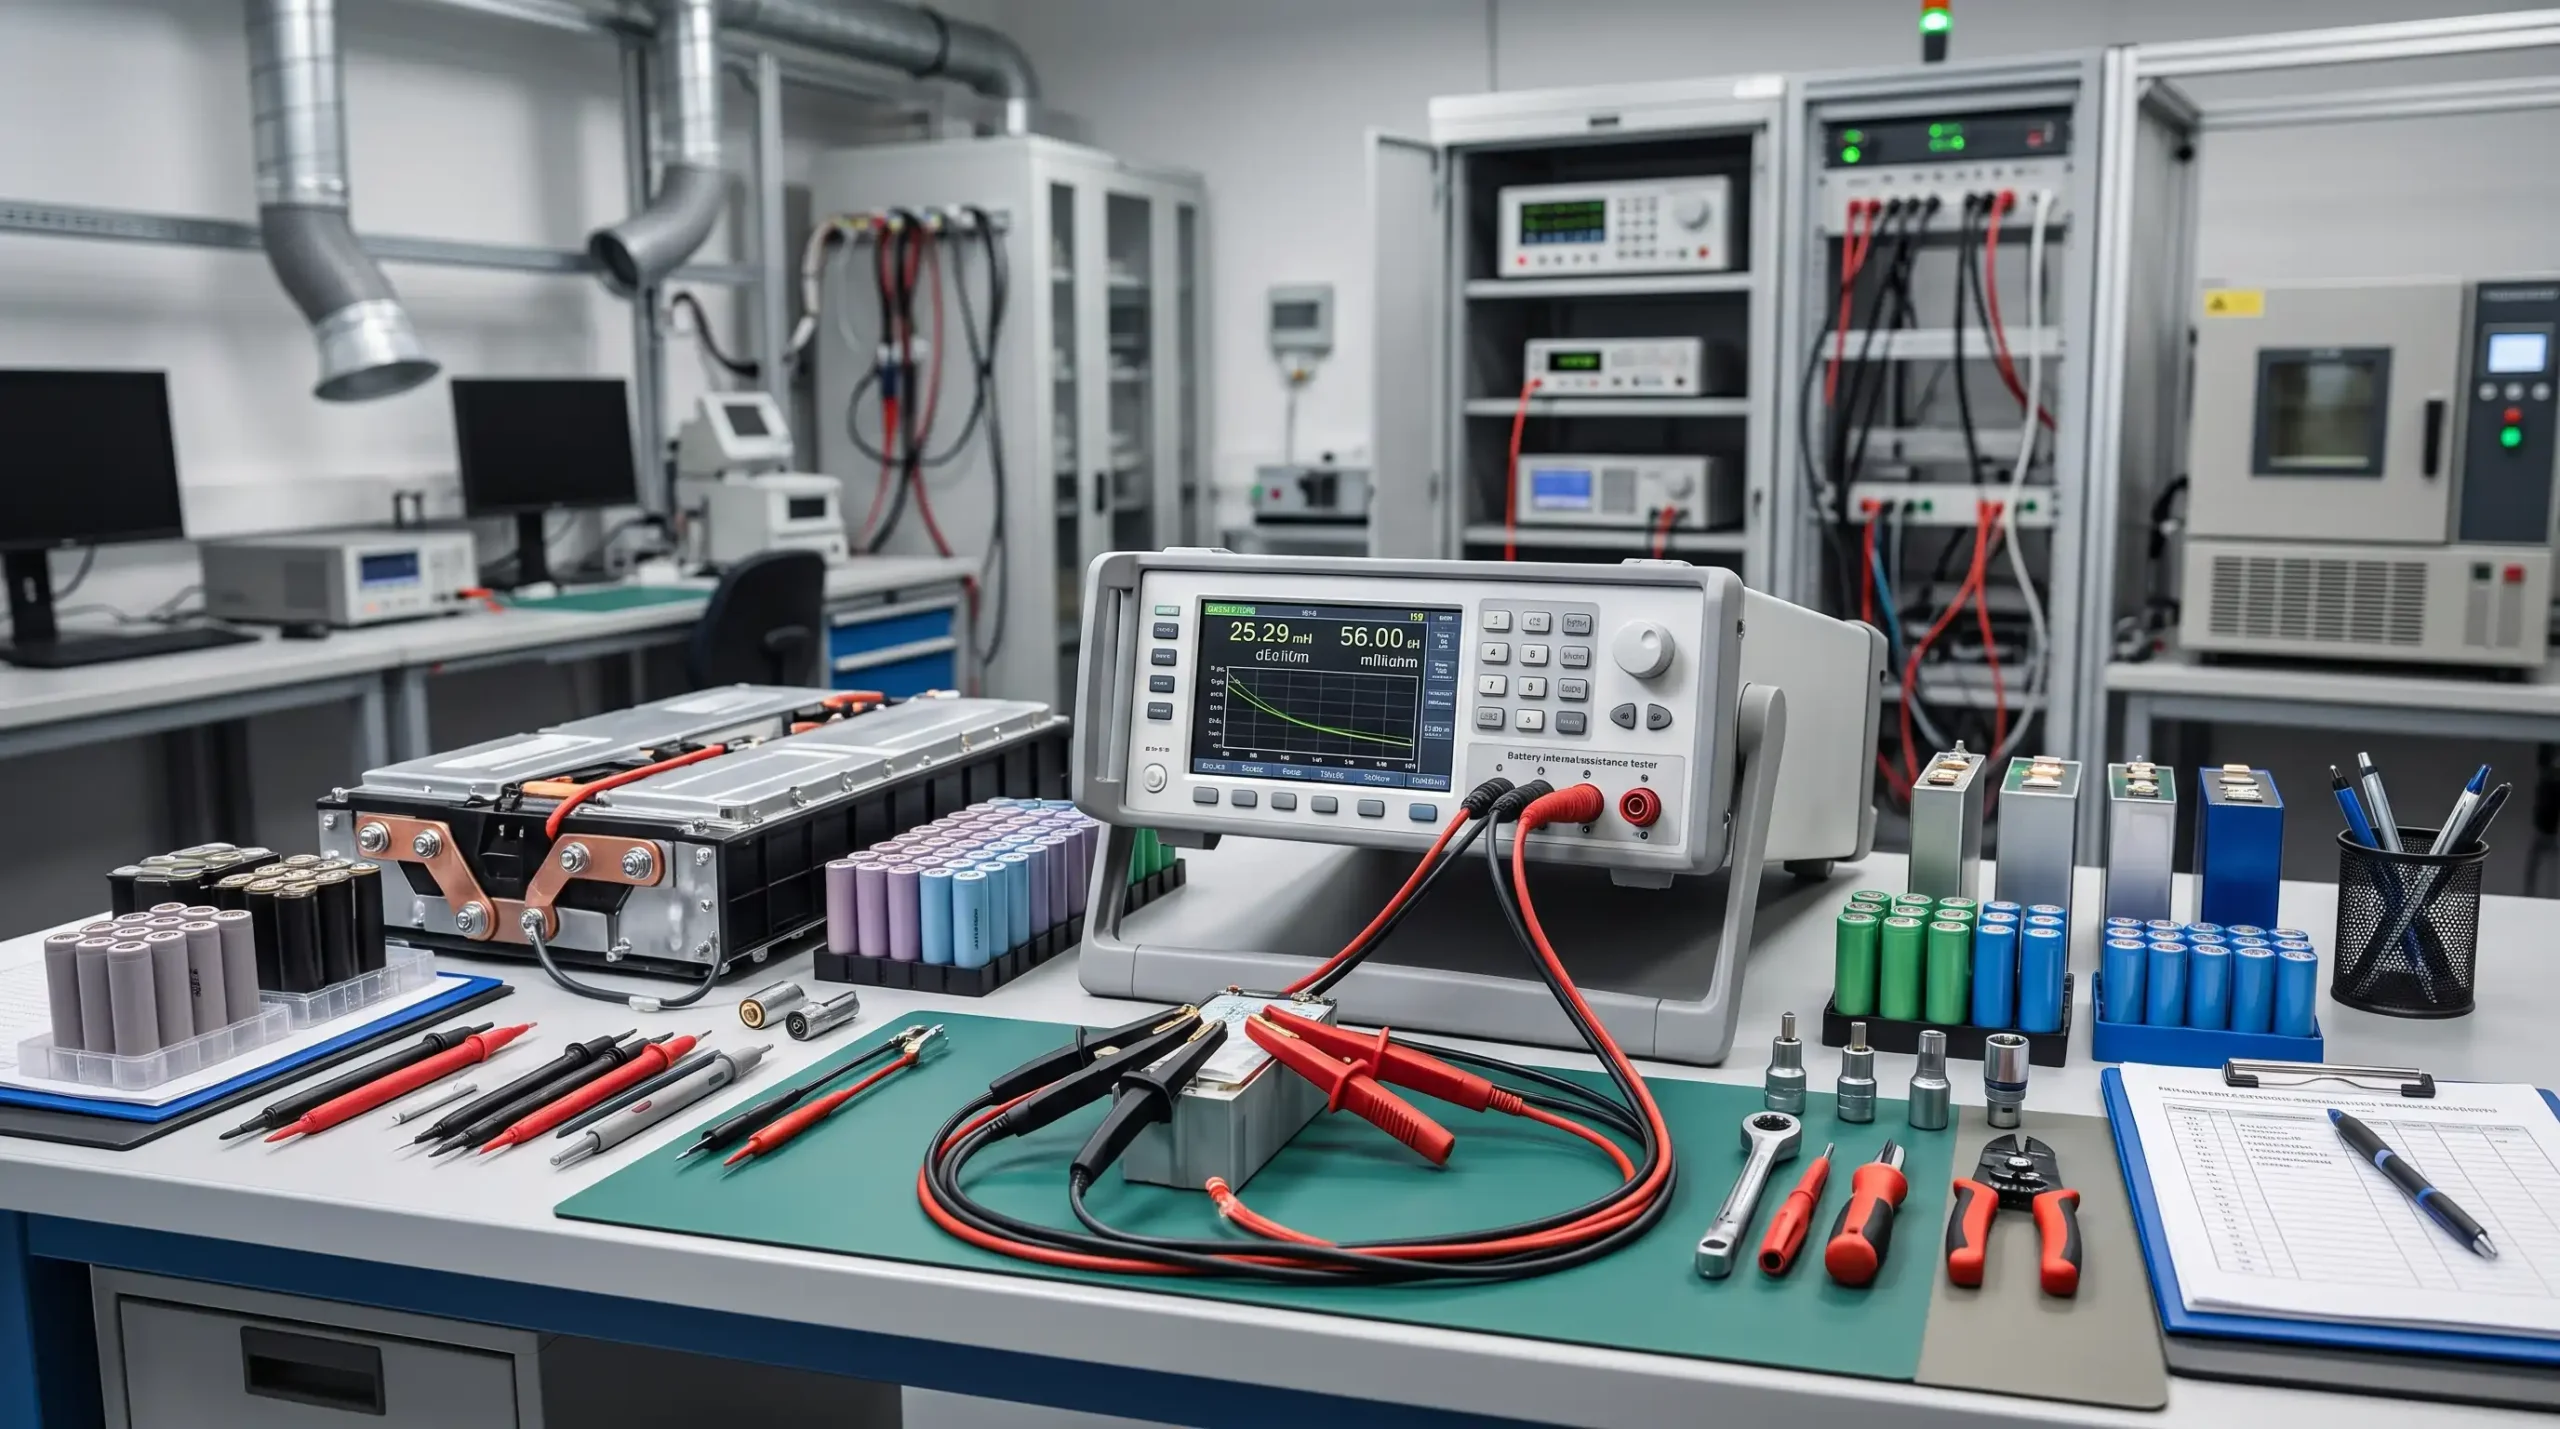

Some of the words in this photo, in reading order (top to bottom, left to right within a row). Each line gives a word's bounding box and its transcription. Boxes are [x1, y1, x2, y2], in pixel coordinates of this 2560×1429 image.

[1230, 621, 1290, 643] 25.29
[1292, 633, 1313, 644] mH
[1340, 626, 1404, 649] 56.00
[1490, 648, 1496, 656] 4
[1507, 751, 1541, 763] Battery
[1630, 759, 1658, 770] tester
